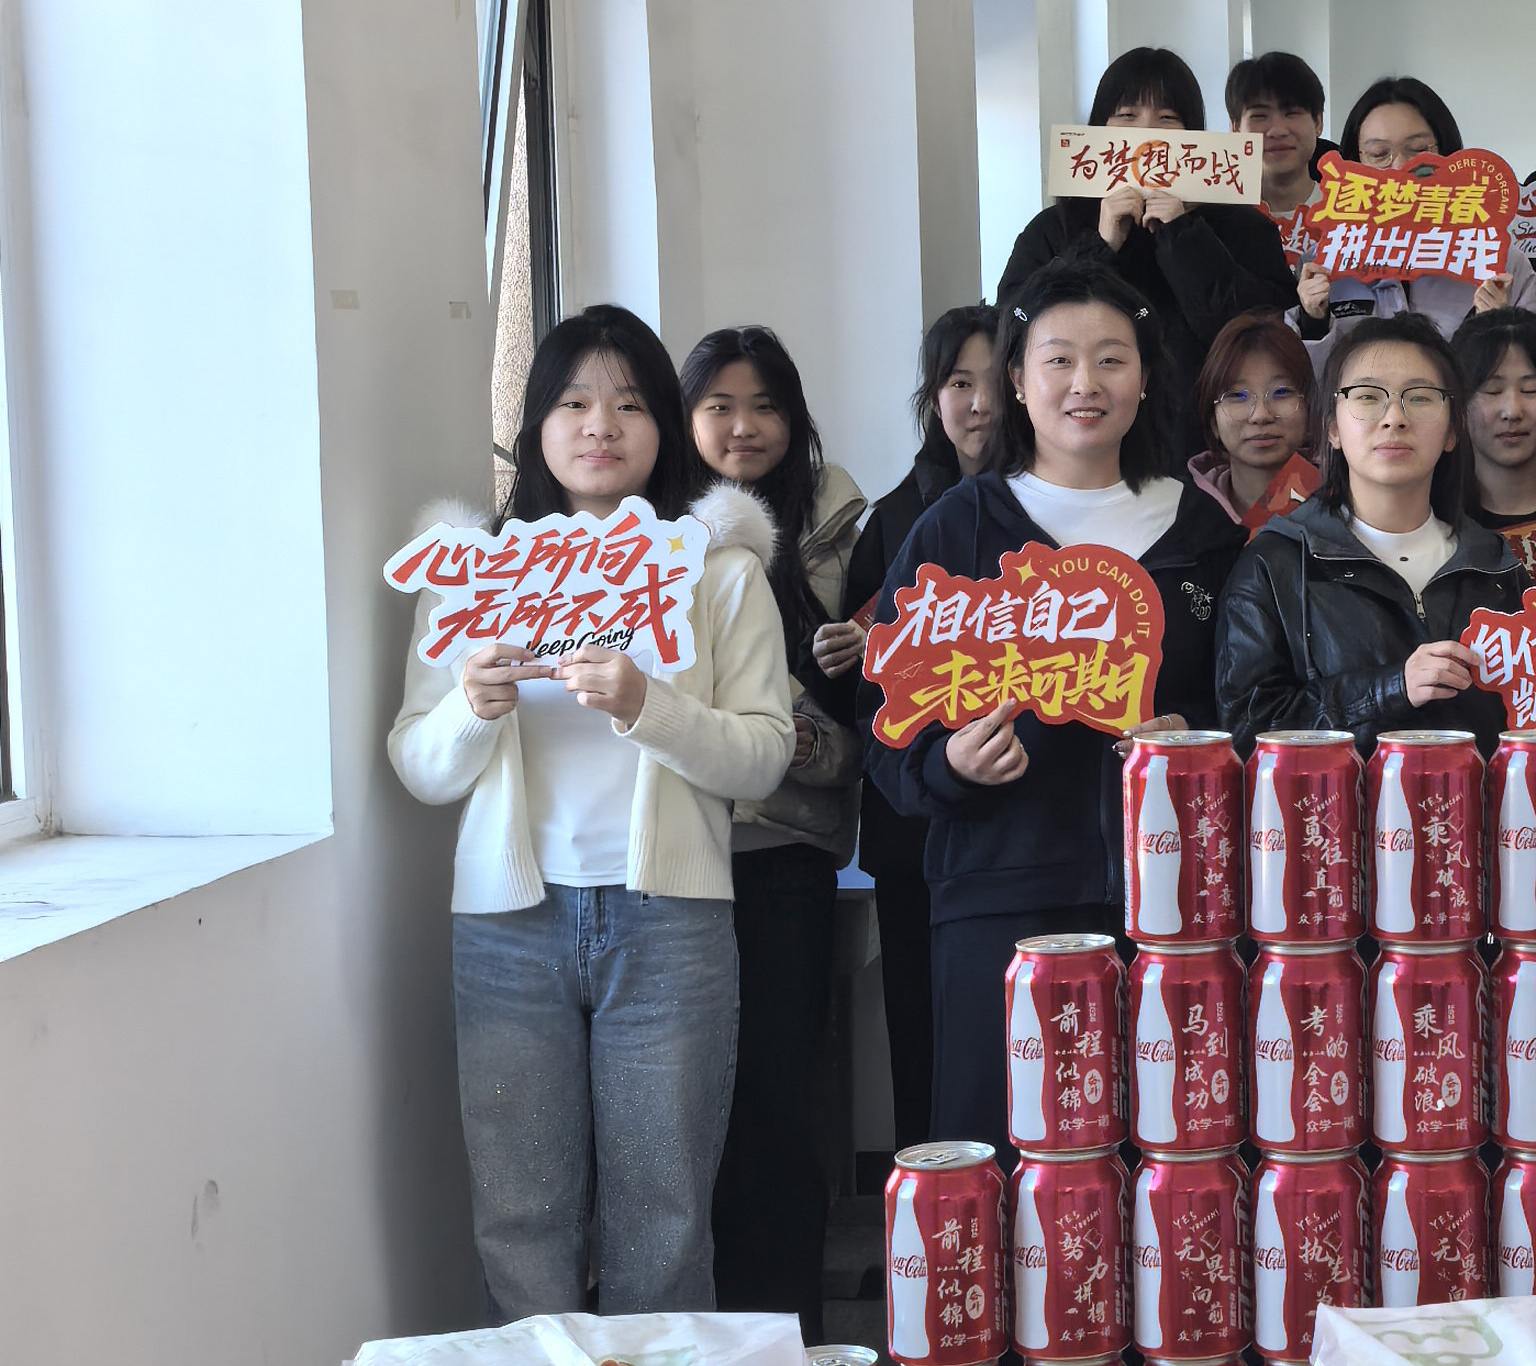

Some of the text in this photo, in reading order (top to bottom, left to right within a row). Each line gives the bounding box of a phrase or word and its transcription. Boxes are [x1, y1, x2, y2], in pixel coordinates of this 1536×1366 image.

[1070, 139, 1244, 195] 为梦想而战
[1312, 162, 1491, 224] 逐梦青春
[1480, 159, 1495, 174] TO
[1495, 172, 1510, 214] DREAM
[1321, 223, 1501, 280] 拼出自我
[391, 511, 653, 593] 心之所向
[872, 578, 1118, 674] 相信自己
[1049, 557, 1151, 637] YOU CAN DO IT
[882, 640, 1150, 740] 未来可期
[1050, 1002, 1105, 1112] 前程似锦
[1182, 1004, 1229, 1110] 马到成功
[1300, 1006, 1349, 1113] 考的全会
[1413, 1003, 1466, 1111] 乘风破浪
[1058, 1115, 1110, 1131] 众学一诺
[1417, 1117, 1468, 1133] 众学一诺
[932, 1218, 986, 1328] 前程似锦
[1175, 1236, 1236, 1323] 无畏向前
